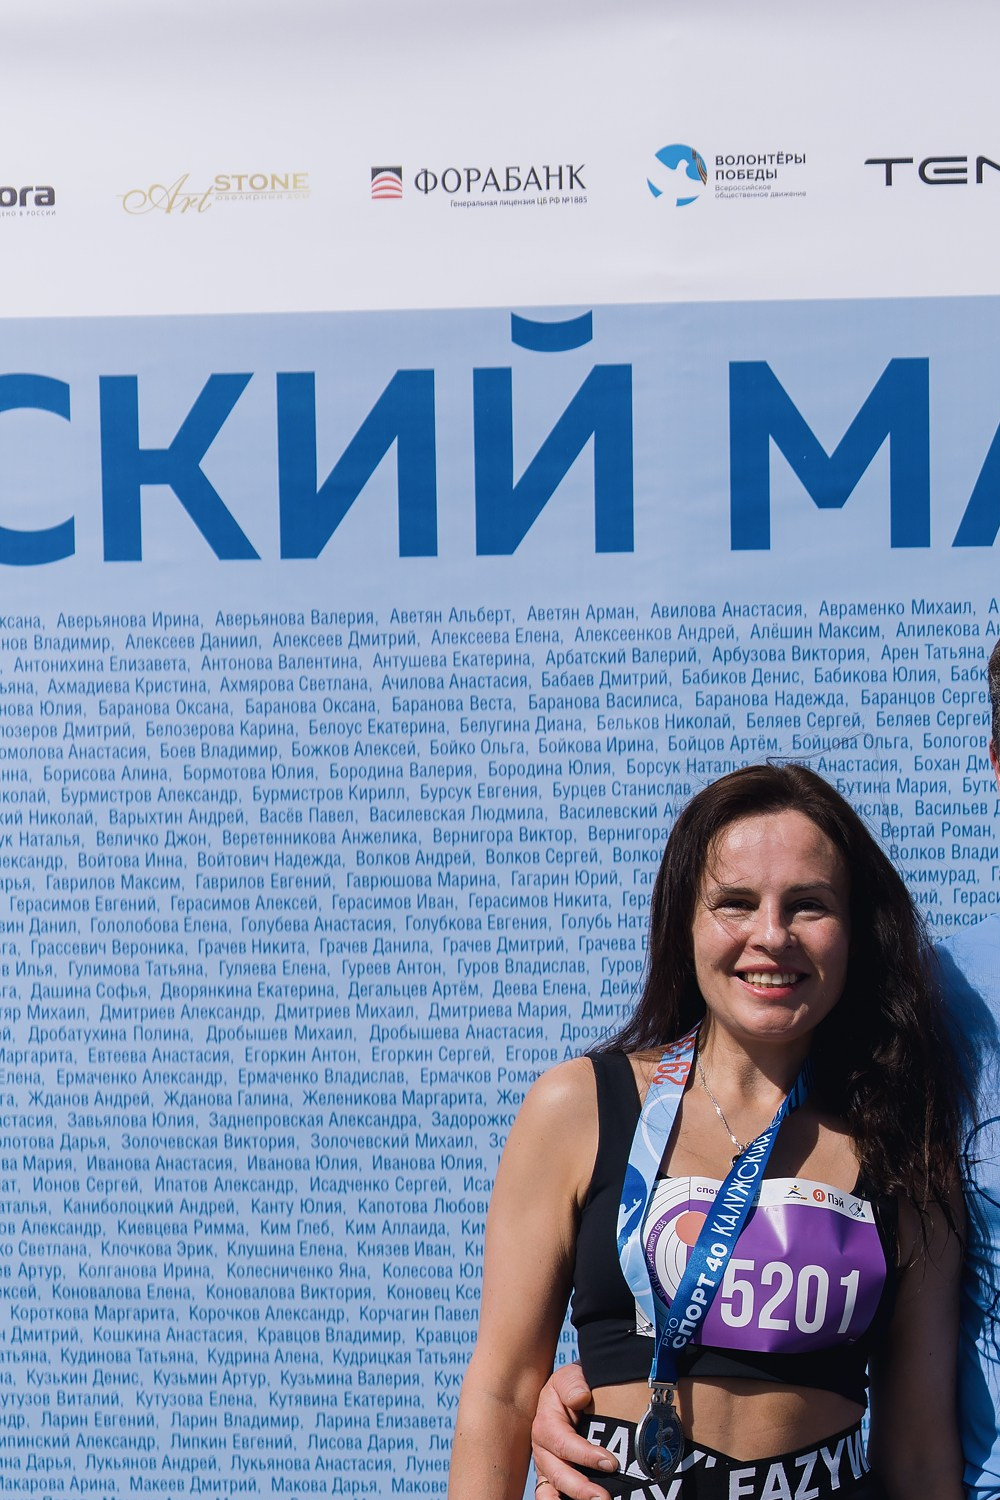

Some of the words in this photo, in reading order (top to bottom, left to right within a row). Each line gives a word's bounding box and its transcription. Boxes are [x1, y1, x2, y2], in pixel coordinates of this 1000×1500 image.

[715, 151, 806, 166] ВОЛОНТЁРЫ
[215, 172, 310, 191] STONE
[414, 164, 587, 194] ФОРАБАНК
[715, 169, 777, 181] ПОБЕДЫ
[116, 173, 215, 214] Art
[715, 184, 772, 193] Всероссийское
[715, 191, 769, 199] общественное
[770, 190, 807, 198] движение
[450, 199, 498, 208] Генеральная
[499, 198, 536, 206] лицензия
[537, 198, 548, 206] ЦБ
[57, 613, 145, 630] Аверьянова
[153, 612, 203, 630] Ирина,
[216, 611, 304, 629] Аверьянова
[312, 609, 377, 627] Валерия,
[390, 608, 441, 623] Аветян
[449, 607, 514, 625] Альберт,
[528, 606, 579, 620] Аветян
[586, 604, 638, 623] Арман,
[651, 603, 715, 618] Авилова
[723, 602, 806, 617] Анастасия,
[820, 601, 904, 619] Авраменко
[912, 599, 975, 615] Михаил,
[90, 918, 179, 933] Гололобова
[185, 918, 232, 933] Елена,
[241, 918, 309, 933] Голубева
[315, 917, 395, 932] Анастасия,
[406, 916, 481, 932] Голубкова
[488, 915, 551, 930] Евгения,
[29, 1092, 88, 1108] Жданов
[95, 1091, 154, 1109] Андрей,
[164, 1092, 232, 1107] Жданова
[239, 1092, 292, 1108] Галина,
[303, 1091, 396, 1105] Желеникова
[403, 1090, 486, 1108] Маргарита,
[711, 1131, 773, 1237] КАЛУЖСКИЙ
[828, 1192, 845, 1208] Пэй
[705, 1242, 728, 1272] 40
[720, 1258, 860, 1334] 5201
[11, 1306, 88, 1323] Короткова
[95, 1306, 178, 1323] Маргарита,
[190, 1306, 259, 1323] Корочков
[266, 1306, 348, 1323] Александр,
[360, 1306, 428, 1324] Корчагин
[672, 1272, 716, 1349] СПОРТ
[662, 1317, 678, 1347] PRO
